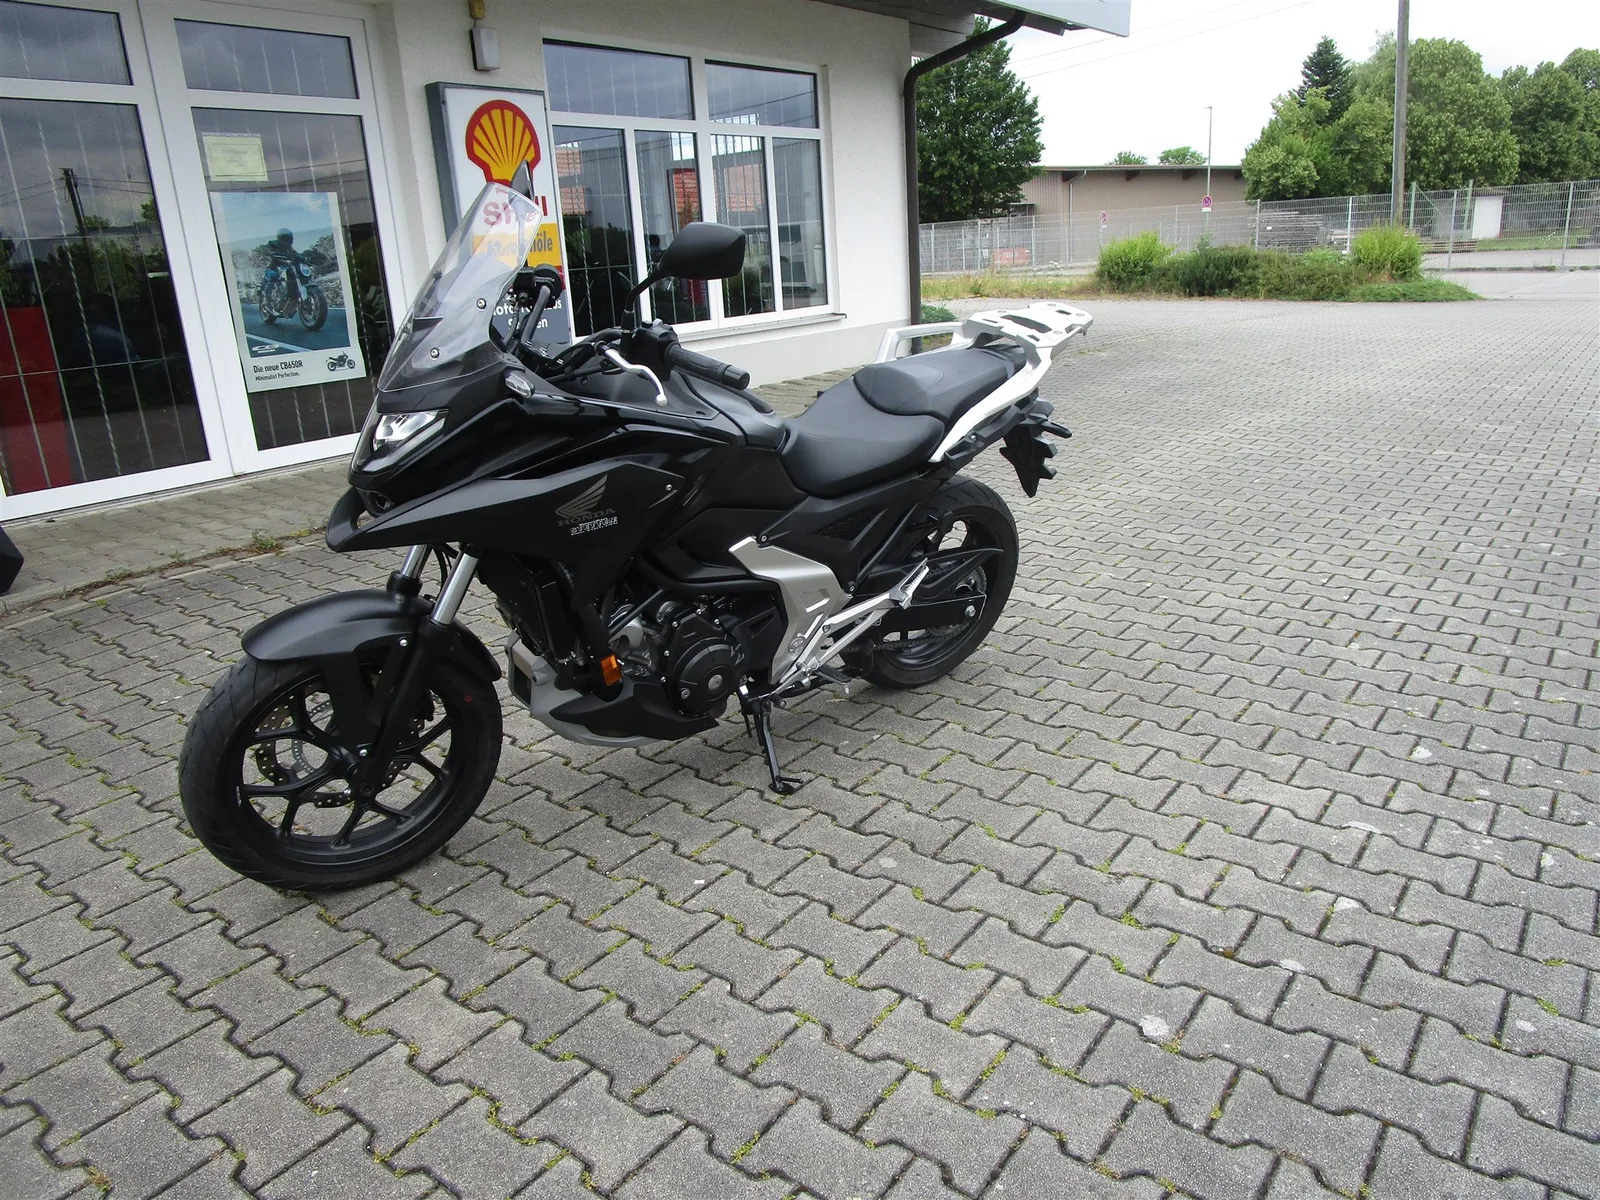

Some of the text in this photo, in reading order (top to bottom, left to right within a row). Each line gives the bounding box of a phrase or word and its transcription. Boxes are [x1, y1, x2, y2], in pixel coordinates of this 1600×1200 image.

[253, 360, 303, 373] Die neue CB650R
[557, 508, 616, 527] HONDA
